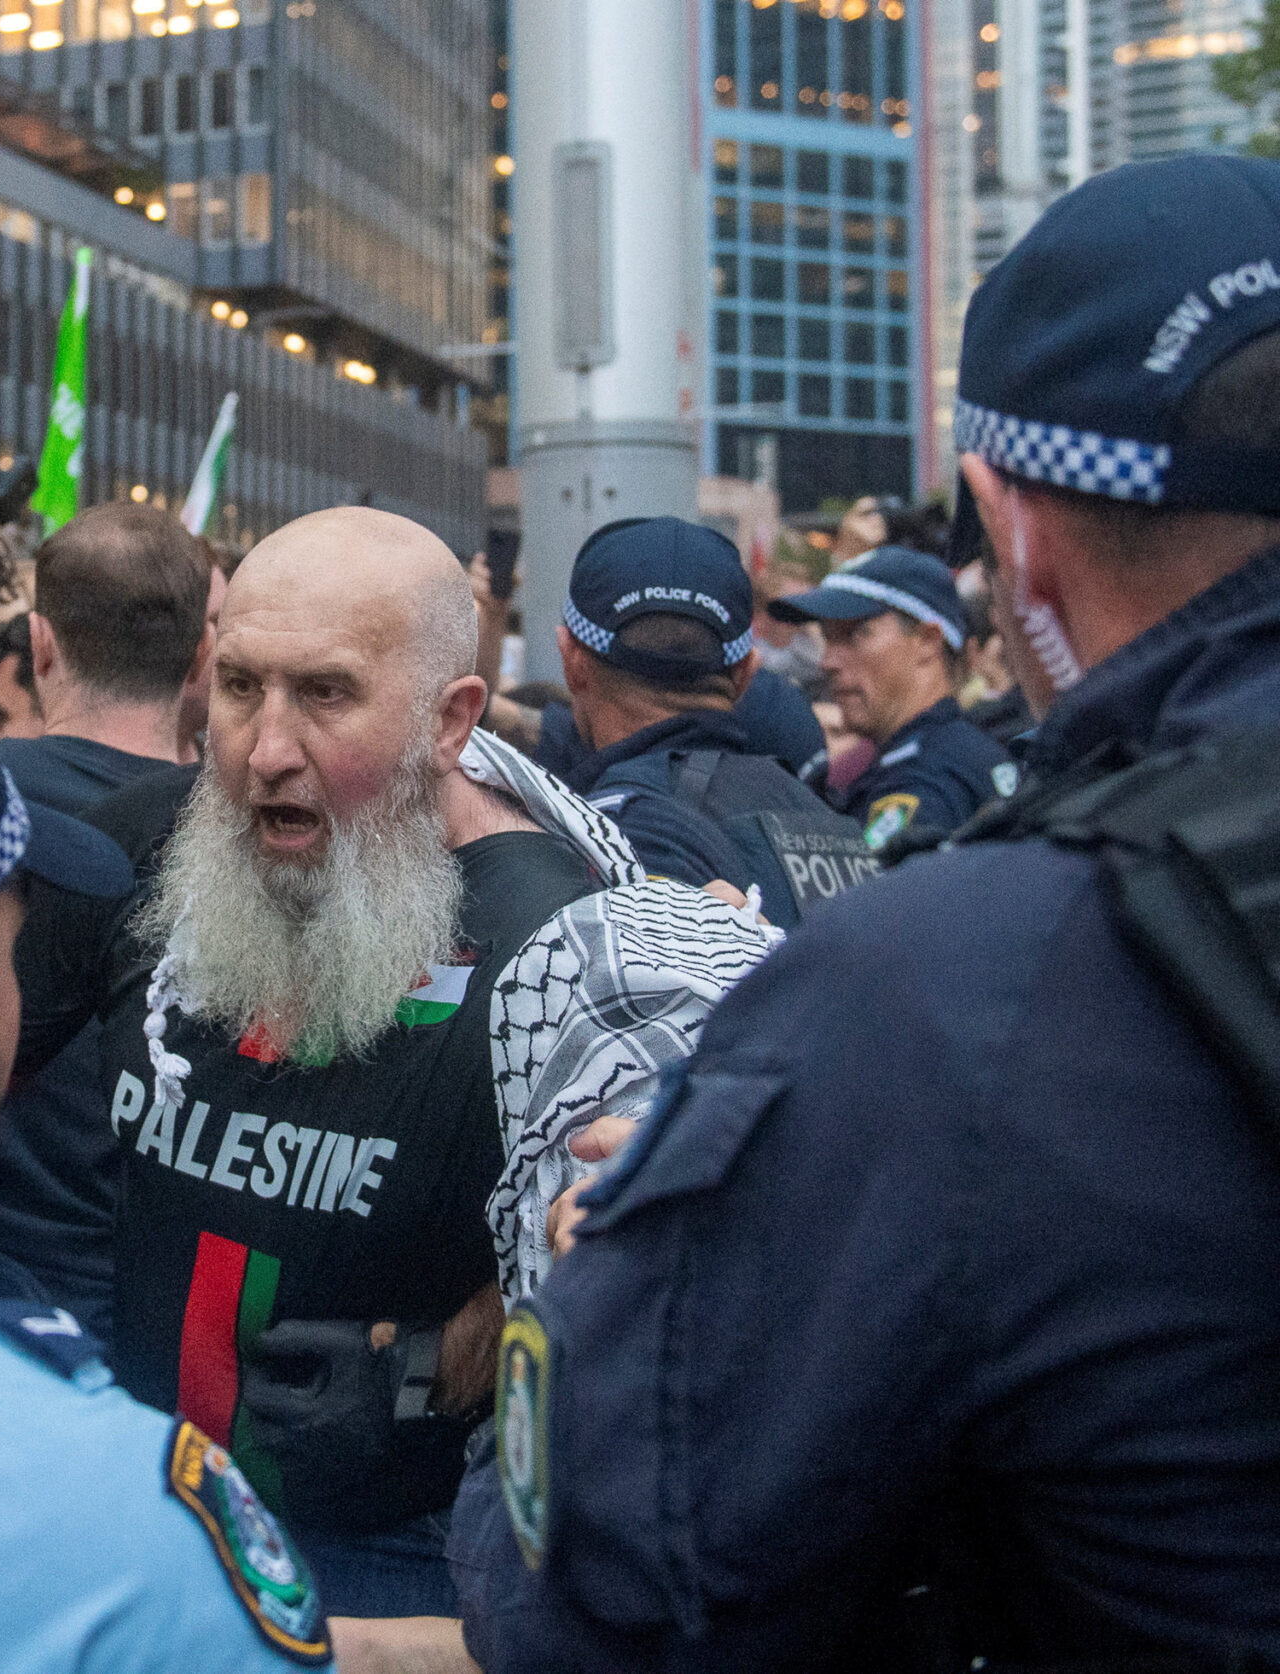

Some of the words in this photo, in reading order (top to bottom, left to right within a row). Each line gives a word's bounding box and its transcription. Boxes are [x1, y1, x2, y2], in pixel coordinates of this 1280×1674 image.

[1144, 292, 1211, 373] NSW
[614, 590, 640, 613] NSW
[645, 586, 692, 601] POLICE
[695, 592, 731, 624] FORCE
[110, 1069, 397, 1217] PALESTINE
